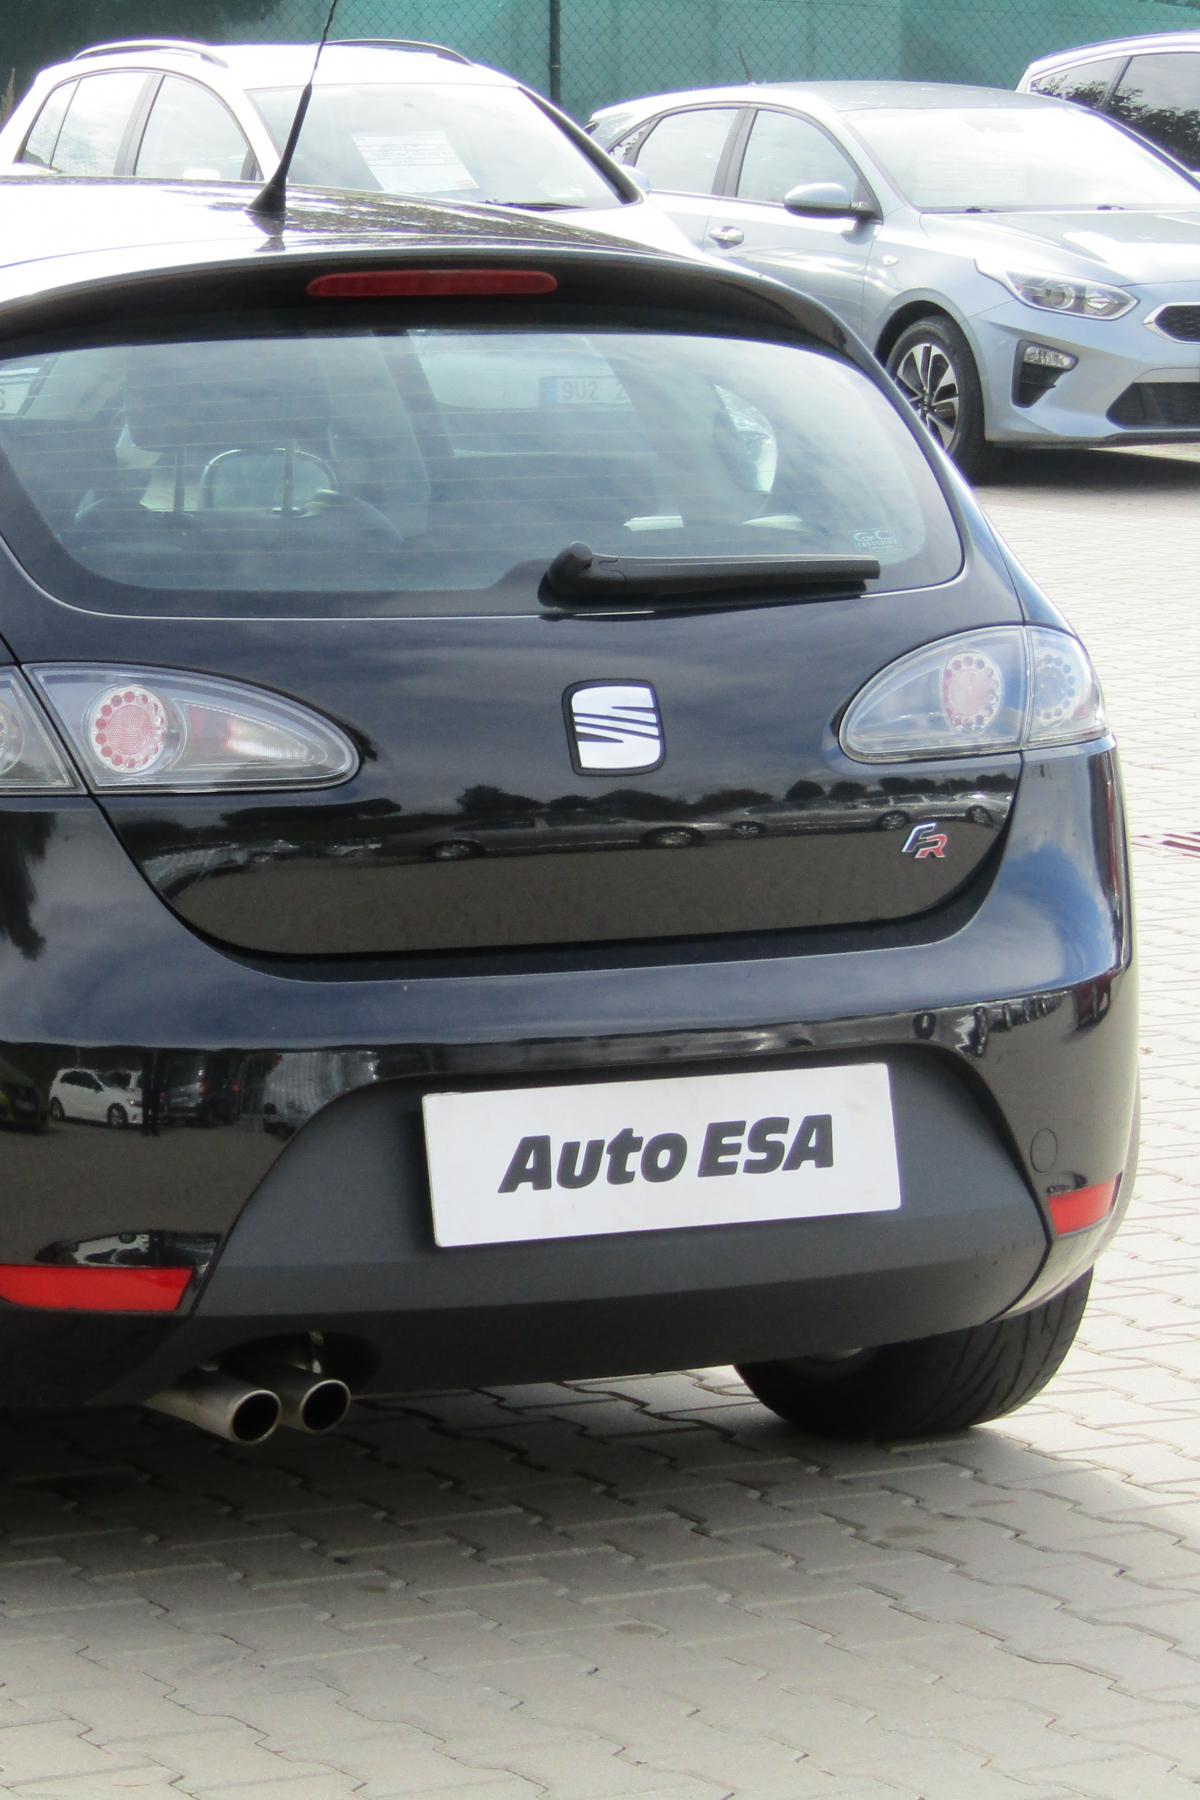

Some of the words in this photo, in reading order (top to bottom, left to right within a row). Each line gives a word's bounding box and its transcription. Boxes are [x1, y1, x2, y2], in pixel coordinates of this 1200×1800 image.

[901, 822, 948, 859] FR
[498, 1128, 688, 1194] Auto
[697, 1114, 834, 1178] ESA
